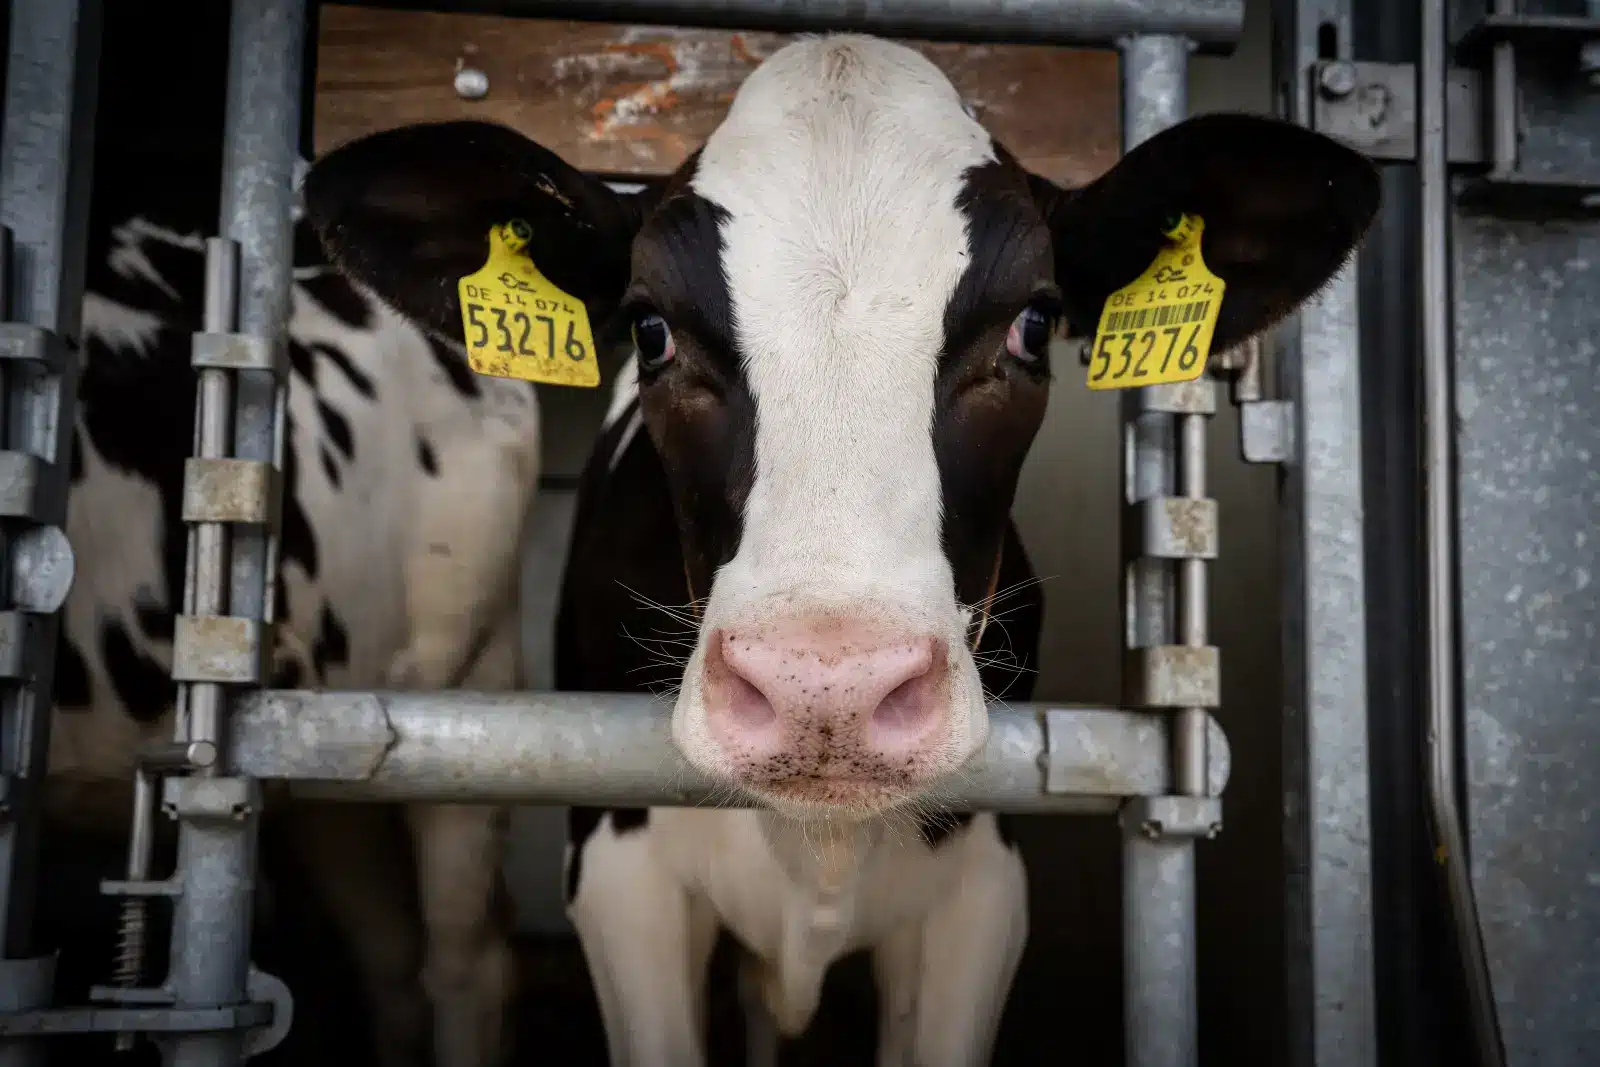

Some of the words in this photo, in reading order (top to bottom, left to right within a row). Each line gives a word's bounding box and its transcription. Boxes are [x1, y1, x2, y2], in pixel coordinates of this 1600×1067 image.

[466, 284, 492, 302] DE
[504, 293, 527, 306] 14
[535, 299, 575, 314] 074
[1112, 292, 1137, 307] DE
[1146, 290, 1167, 303] 14
[1177, 284, 1214, 299] 074
[468, 303, 586, 361] 53276
[1092, 324, 1201, 381] 53276
